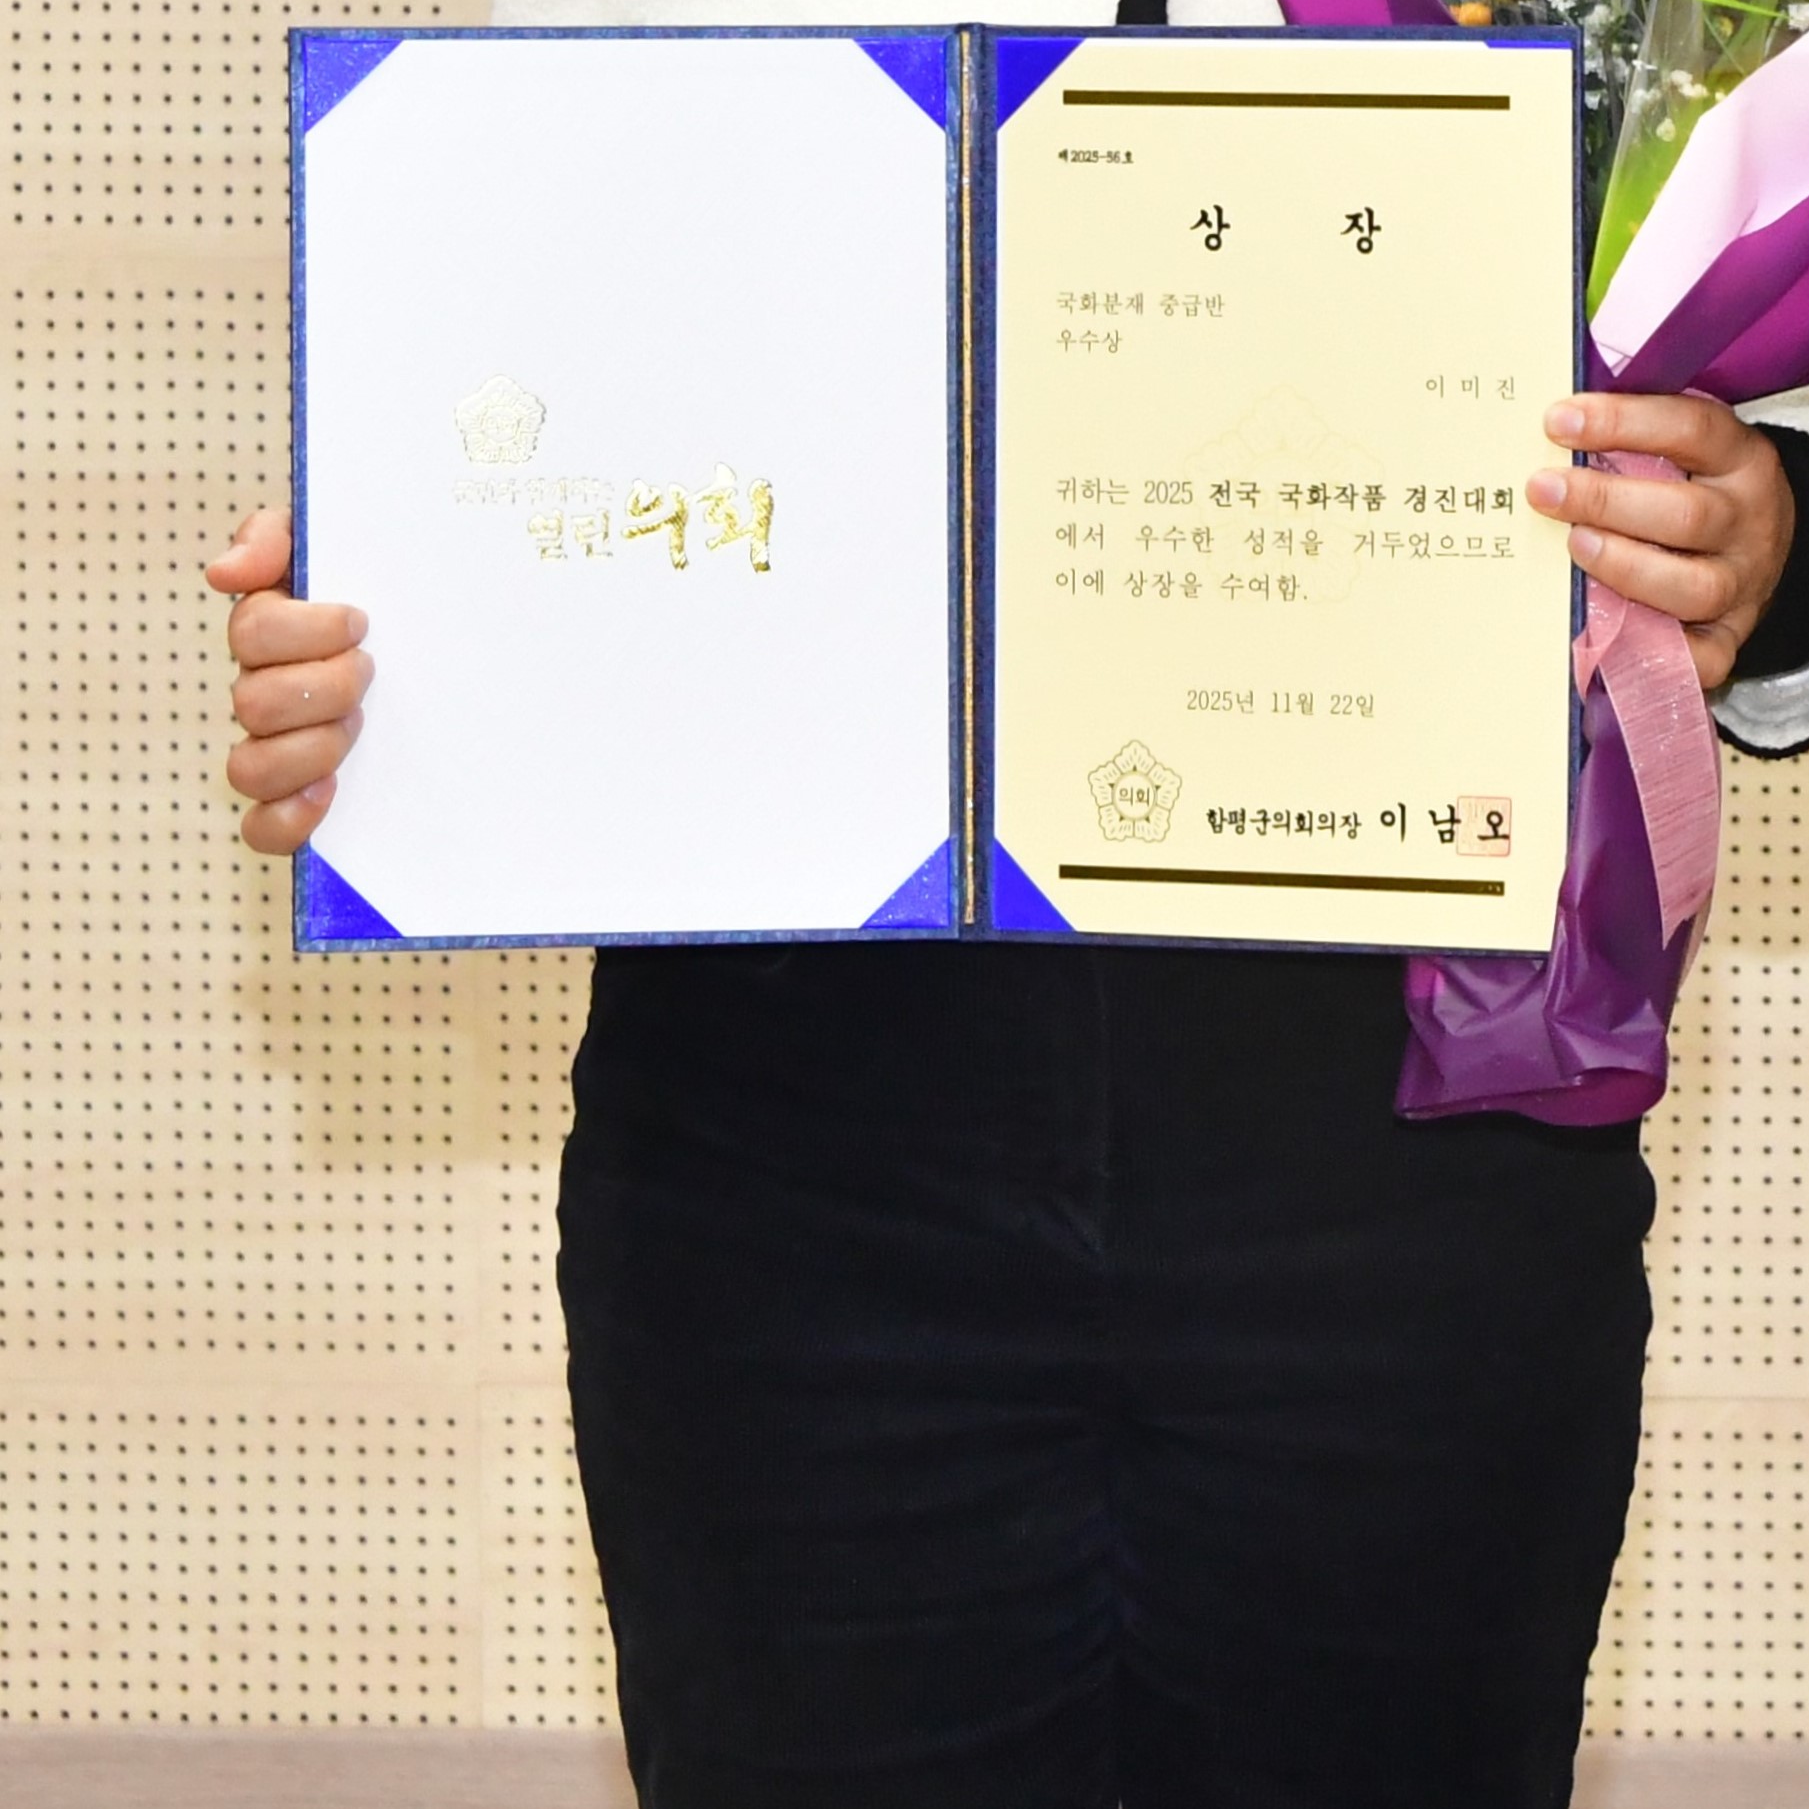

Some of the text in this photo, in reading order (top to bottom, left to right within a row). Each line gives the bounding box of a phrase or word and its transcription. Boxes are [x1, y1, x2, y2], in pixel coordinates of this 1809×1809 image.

[1190, 204, 1382, 255] 상 장
[1057, 291, 1225, 318] 국화분재 중급반
[1056, 328, 1123, 354] 우수상
[1425, 374, 1515, 401] 이 미 진
[1056, 476, 1513, 515] 귀하는 2025 전국 국화작품 경진대회
[620, 461, 776, 574] 의회
[1055, 522, 1515, 560] 에서 우수한 성적을 거두었으므로
[1055, 567, 1308, 602] 이에 상장을 수여함.
[1186, 689, 1374, 718] 2025년 11월 22일
[1119, 786, 1150, 807] 의회
[1379, 802, 1407, 842] 이
[1428, 804, 1462, 844] 남
[1477, 810, 1511, 842] 오
